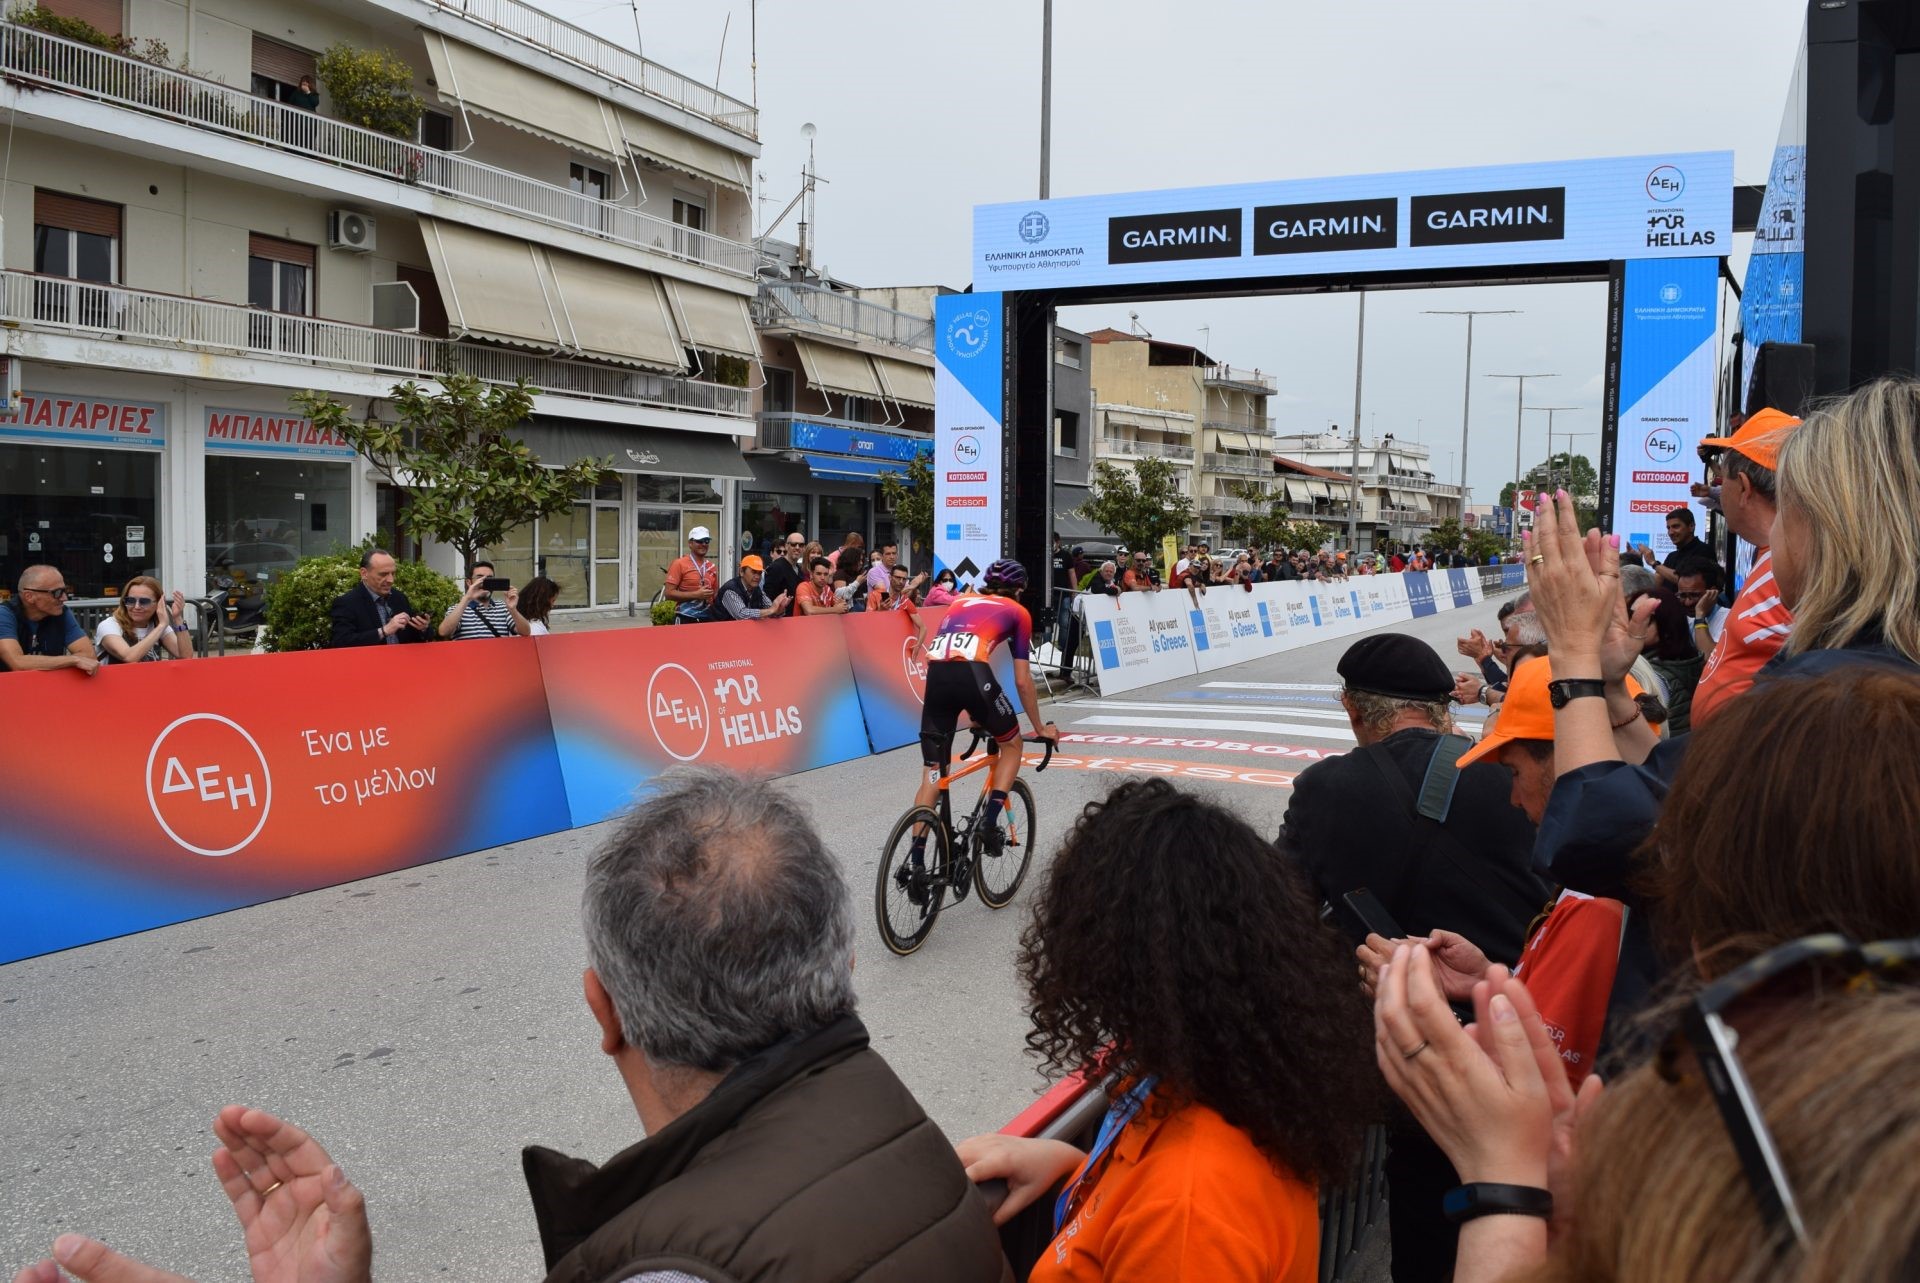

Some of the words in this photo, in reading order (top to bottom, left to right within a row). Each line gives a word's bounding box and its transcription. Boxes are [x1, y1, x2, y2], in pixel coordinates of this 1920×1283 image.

[1427, 204, 1549, 231] GARMIN
[1269, 214, 1382, 240] GARMIN
[1122, 224, 1227, 249] GARMIN
[1647, 231, 1715, 247] HELLAS
[985, 250, 1027, 262] ΕΛΛΗΝΙΚΗ
[1028, 247, 1084, 259] ΔΗΜΟΚΡΑΤΙΑ
[1037, 257, 1081, 270] Αθλητισμού
[0, 397, 155, 434] ΠΑΤΑΡΙΕΣ
[957, 443, 977, 456] ΔΕΗ
[1649, 437, 1676, 453] ΔΕΗ
[626, 449, 660, 464] Carlsberg
[947, 497, 984, 506] betsson
[1234, 611, 1242, 622] you
[1149, 619, 1157, 632] All
[1156, 621, 1166, 634] you
[1166, 618, 1179, 630] want
[953, 632, 974, 649] 57
[1151, 635, 1161, 653] is
[1160, 634, 1189, 651] Greece.
[708, 659, 754, 671] INTERNATIONAL
[908, 657, 928, 681] ΔΕ
[655, 692, 703, 730] ΔΕΗ
[718, 706, 727, 715] OF
[720, 705, 803, 748] HELLAS
[301, 729, 352, 757] Ένα
[360, 726, 390, 755] με
[162, 756, 257, 810] ΔΕΗ
[314, 782, 347, 806] το
[354, 766, 437, 806] μέλλον
